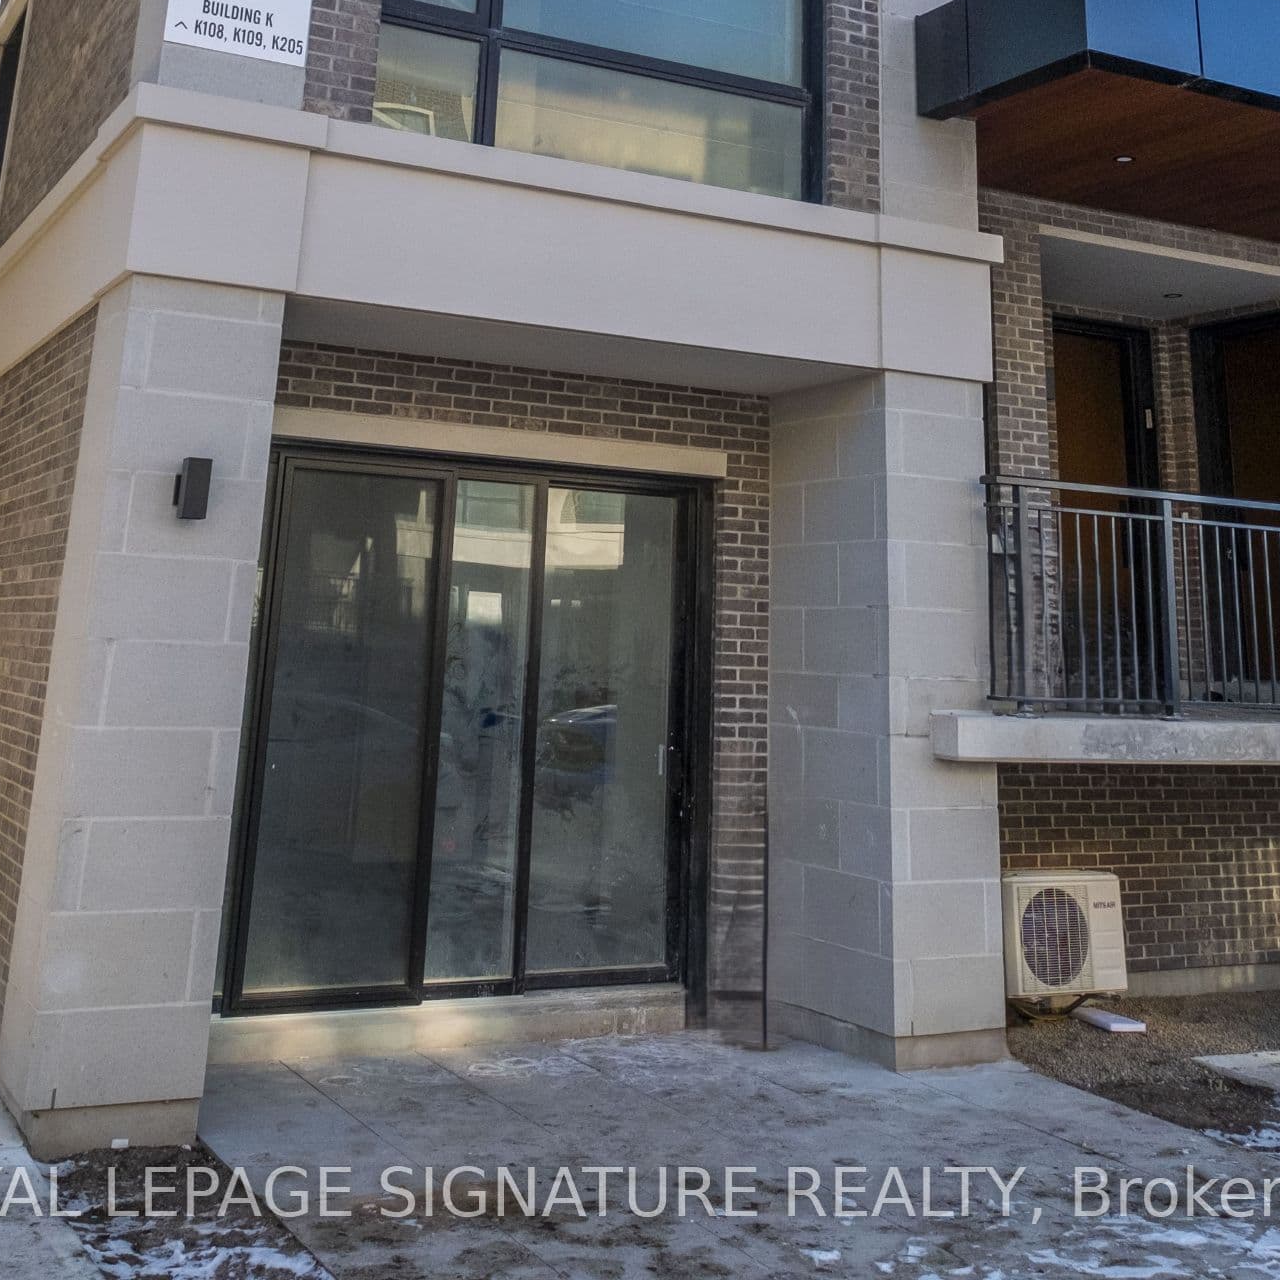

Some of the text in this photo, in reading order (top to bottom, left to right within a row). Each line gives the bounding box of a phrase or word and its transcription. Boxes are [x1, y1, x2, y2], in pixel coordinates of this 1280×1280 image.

[202, 0, 274, 27] BUILDING K
[194, 19, 304, 55] K108, K109, K205
